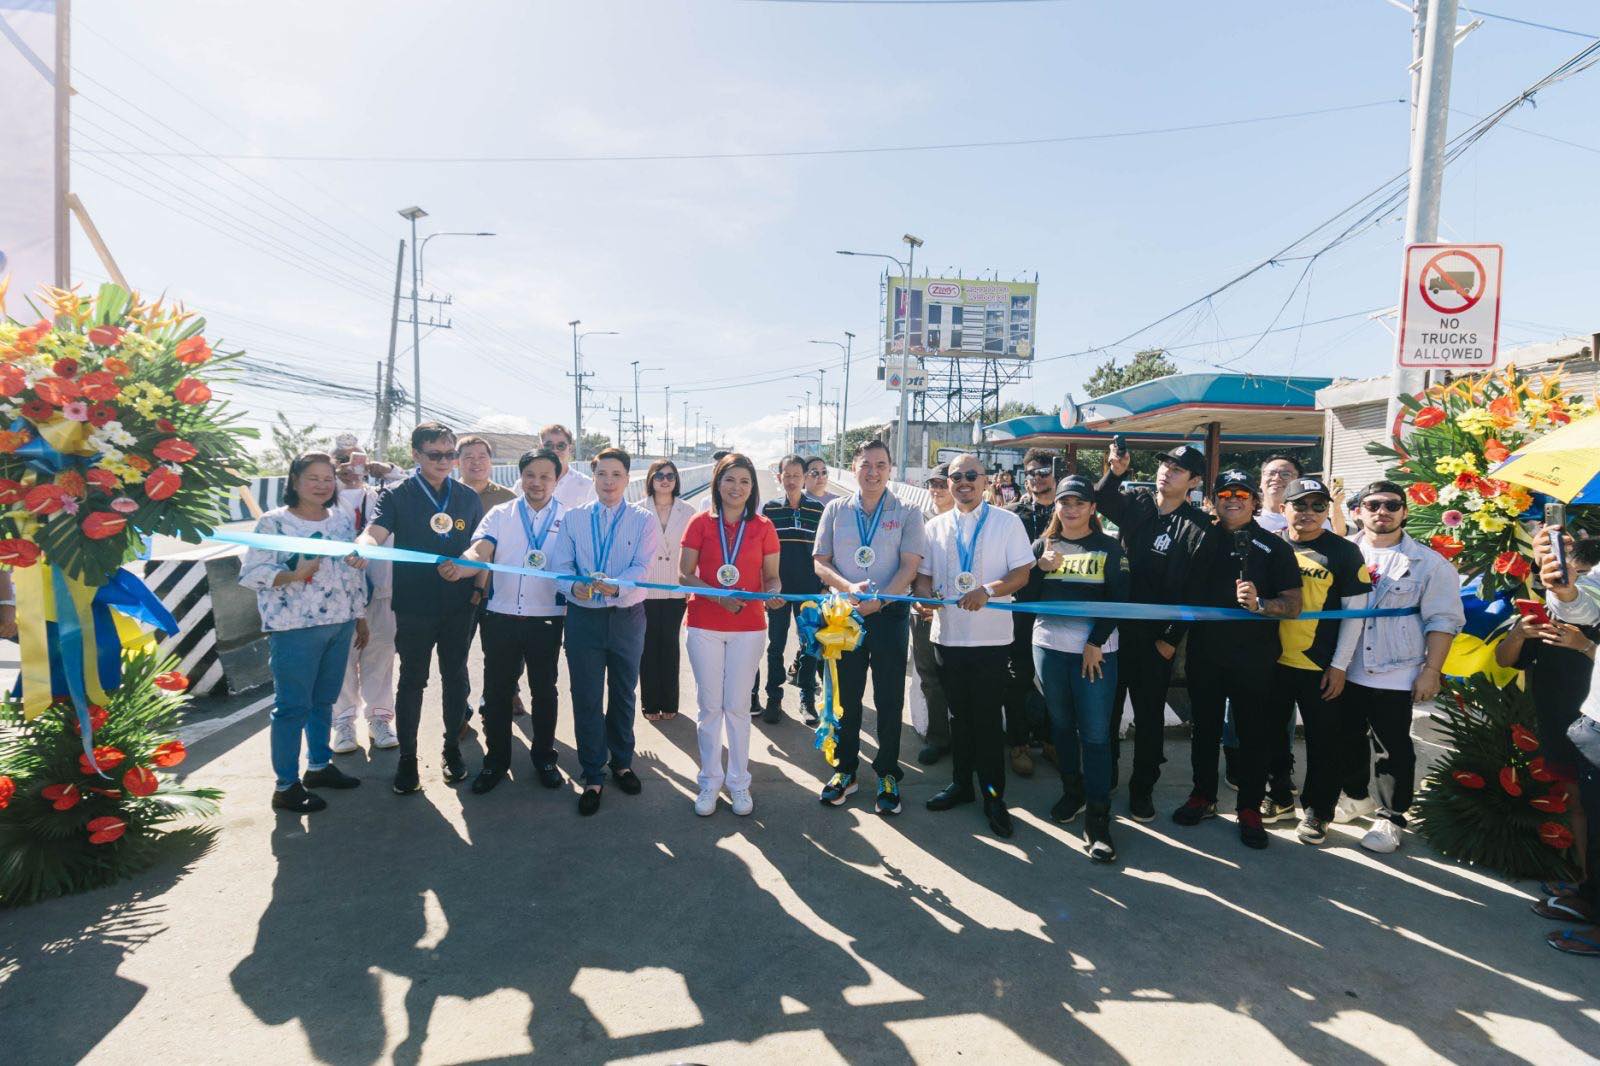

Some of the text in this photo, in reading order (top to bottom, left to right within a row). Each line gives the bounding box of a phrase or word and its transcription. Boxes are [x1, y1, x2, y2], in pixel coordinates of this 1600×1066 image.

[1440, 318, 1460, 329] NO
[1421, 333, 1478, 345] TRUCKS
[1414, 348, 1483, 360] ALLOWED
[1062, 559, 1098, 575] TEKKI
